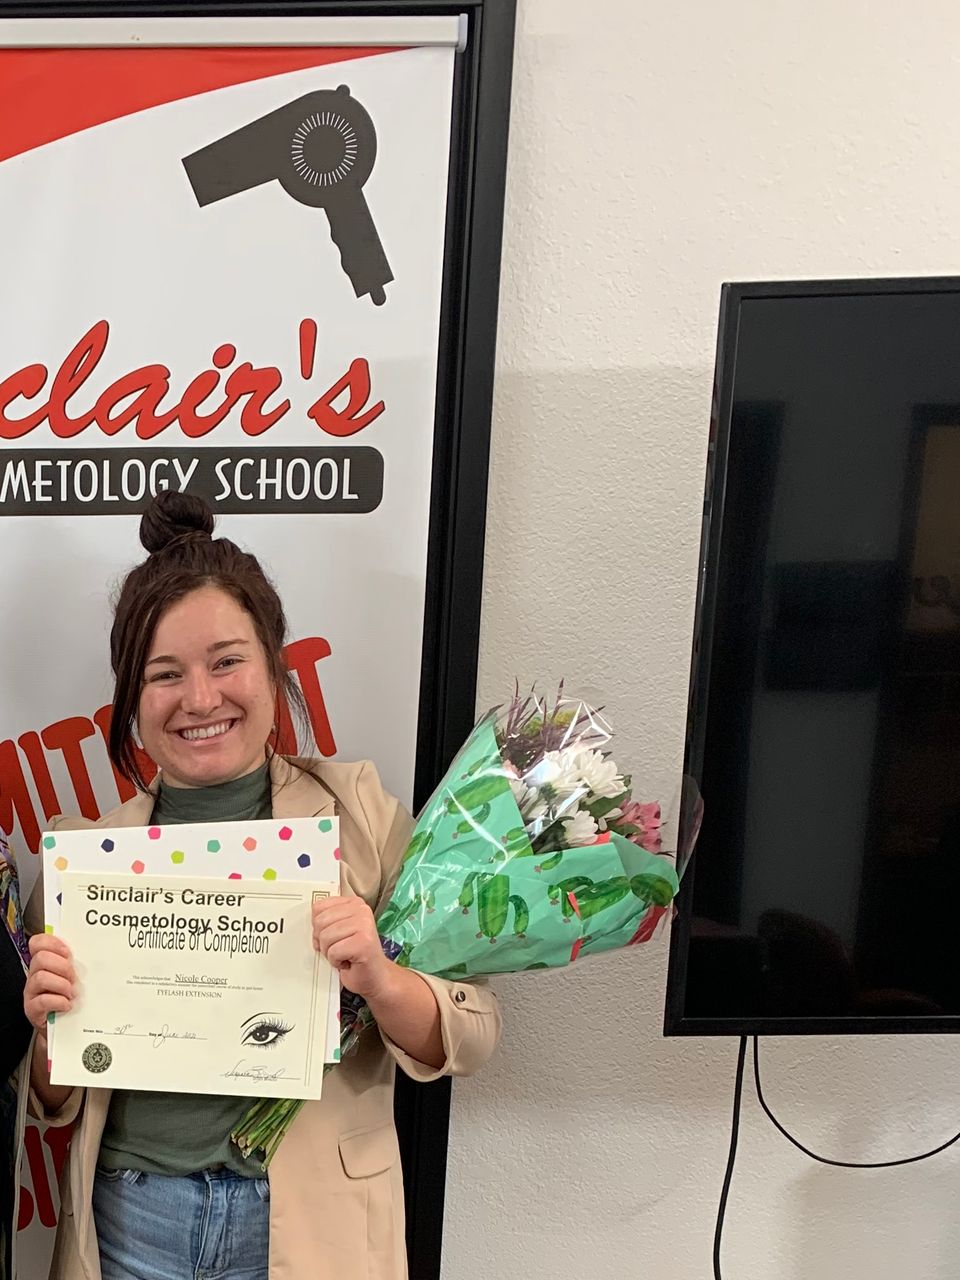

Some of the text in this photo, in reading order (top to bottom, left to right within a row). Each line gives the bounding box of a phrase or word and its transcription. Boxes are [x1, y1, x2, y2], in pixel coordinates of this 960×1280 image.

[214, 457, 359, 501] SCHOOL
[87, 884, 245, 907] Sinclair’s Career
[85, 909, 284, 934] Cosmetology School
[128, 922, 269, 959] Certificate of Completion
[175, 974, 199, 984] Nicole
[200, 975, 228, 985] Cooper
